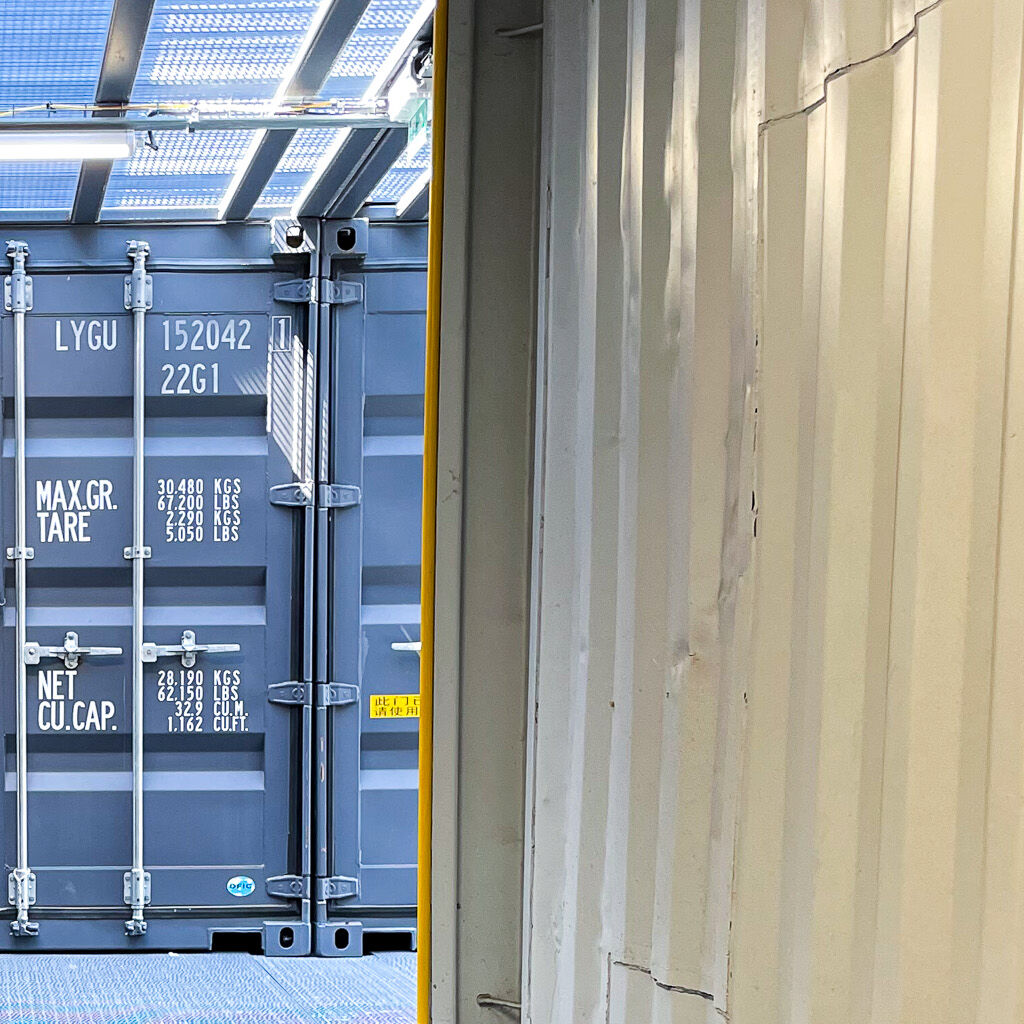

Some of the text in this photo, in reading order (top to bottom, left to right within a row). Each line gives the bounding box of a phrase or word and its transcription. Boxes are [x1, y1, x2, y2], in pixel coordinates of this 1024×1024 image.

[54, 317, 286, 351] LYGU 152042 1
[160, 363, 219, 395] 22G1
[214, 477, 241, 495] KGS
[36, 479, 118, 512] MAX.GR.
[214, 494, 240, 510] LBS
[213, 509, 241, 526] KGS
[36, 511, 91, 543] TARE
[213, 525, 239, 542] LBS
[37, 670, 78, 701] NET
[213, 669, 241, 686] KGS
[213, 685, 239, 701] LBS
[37, 701, 118, 731] CU.CAP.
[175, 700, 249, 717] 32.9 CU.M.
[213, 716, 249, 732] CU.FT.
